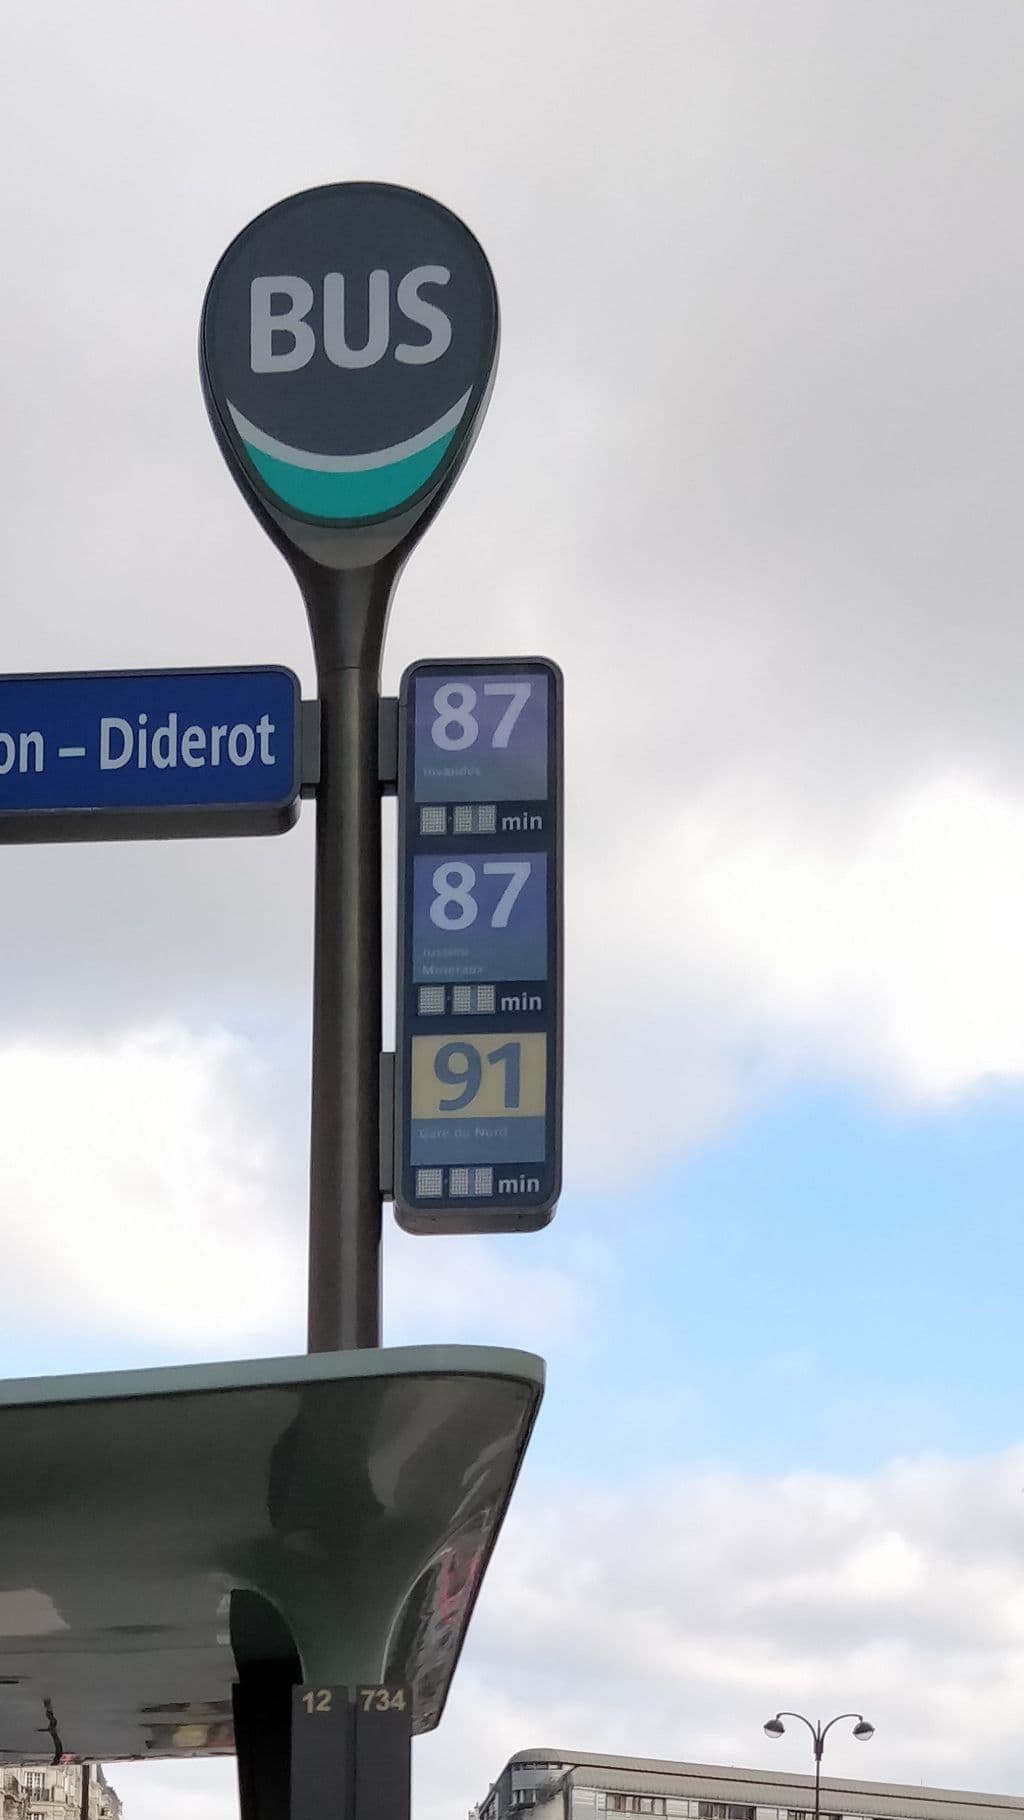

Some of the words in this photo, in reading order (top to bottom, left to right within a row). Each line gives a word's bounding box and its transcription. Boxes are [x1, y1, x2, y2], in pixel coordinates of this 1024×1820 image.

[250, 265, 452, 373] BUS
[100, 712, 276, 770] Diderot
[431, 682, 532, 751] 87
[501, 812, 543, 831] min
[429, 861, 532, 931] 87
[500, 992, 542, 1011] min
[434, 1042, 522, 1111] 91
[498, 1174, 540, 1193] min
[302, 1689, 332, 1714] 12
[360, 1688, 407, 1713] 734
